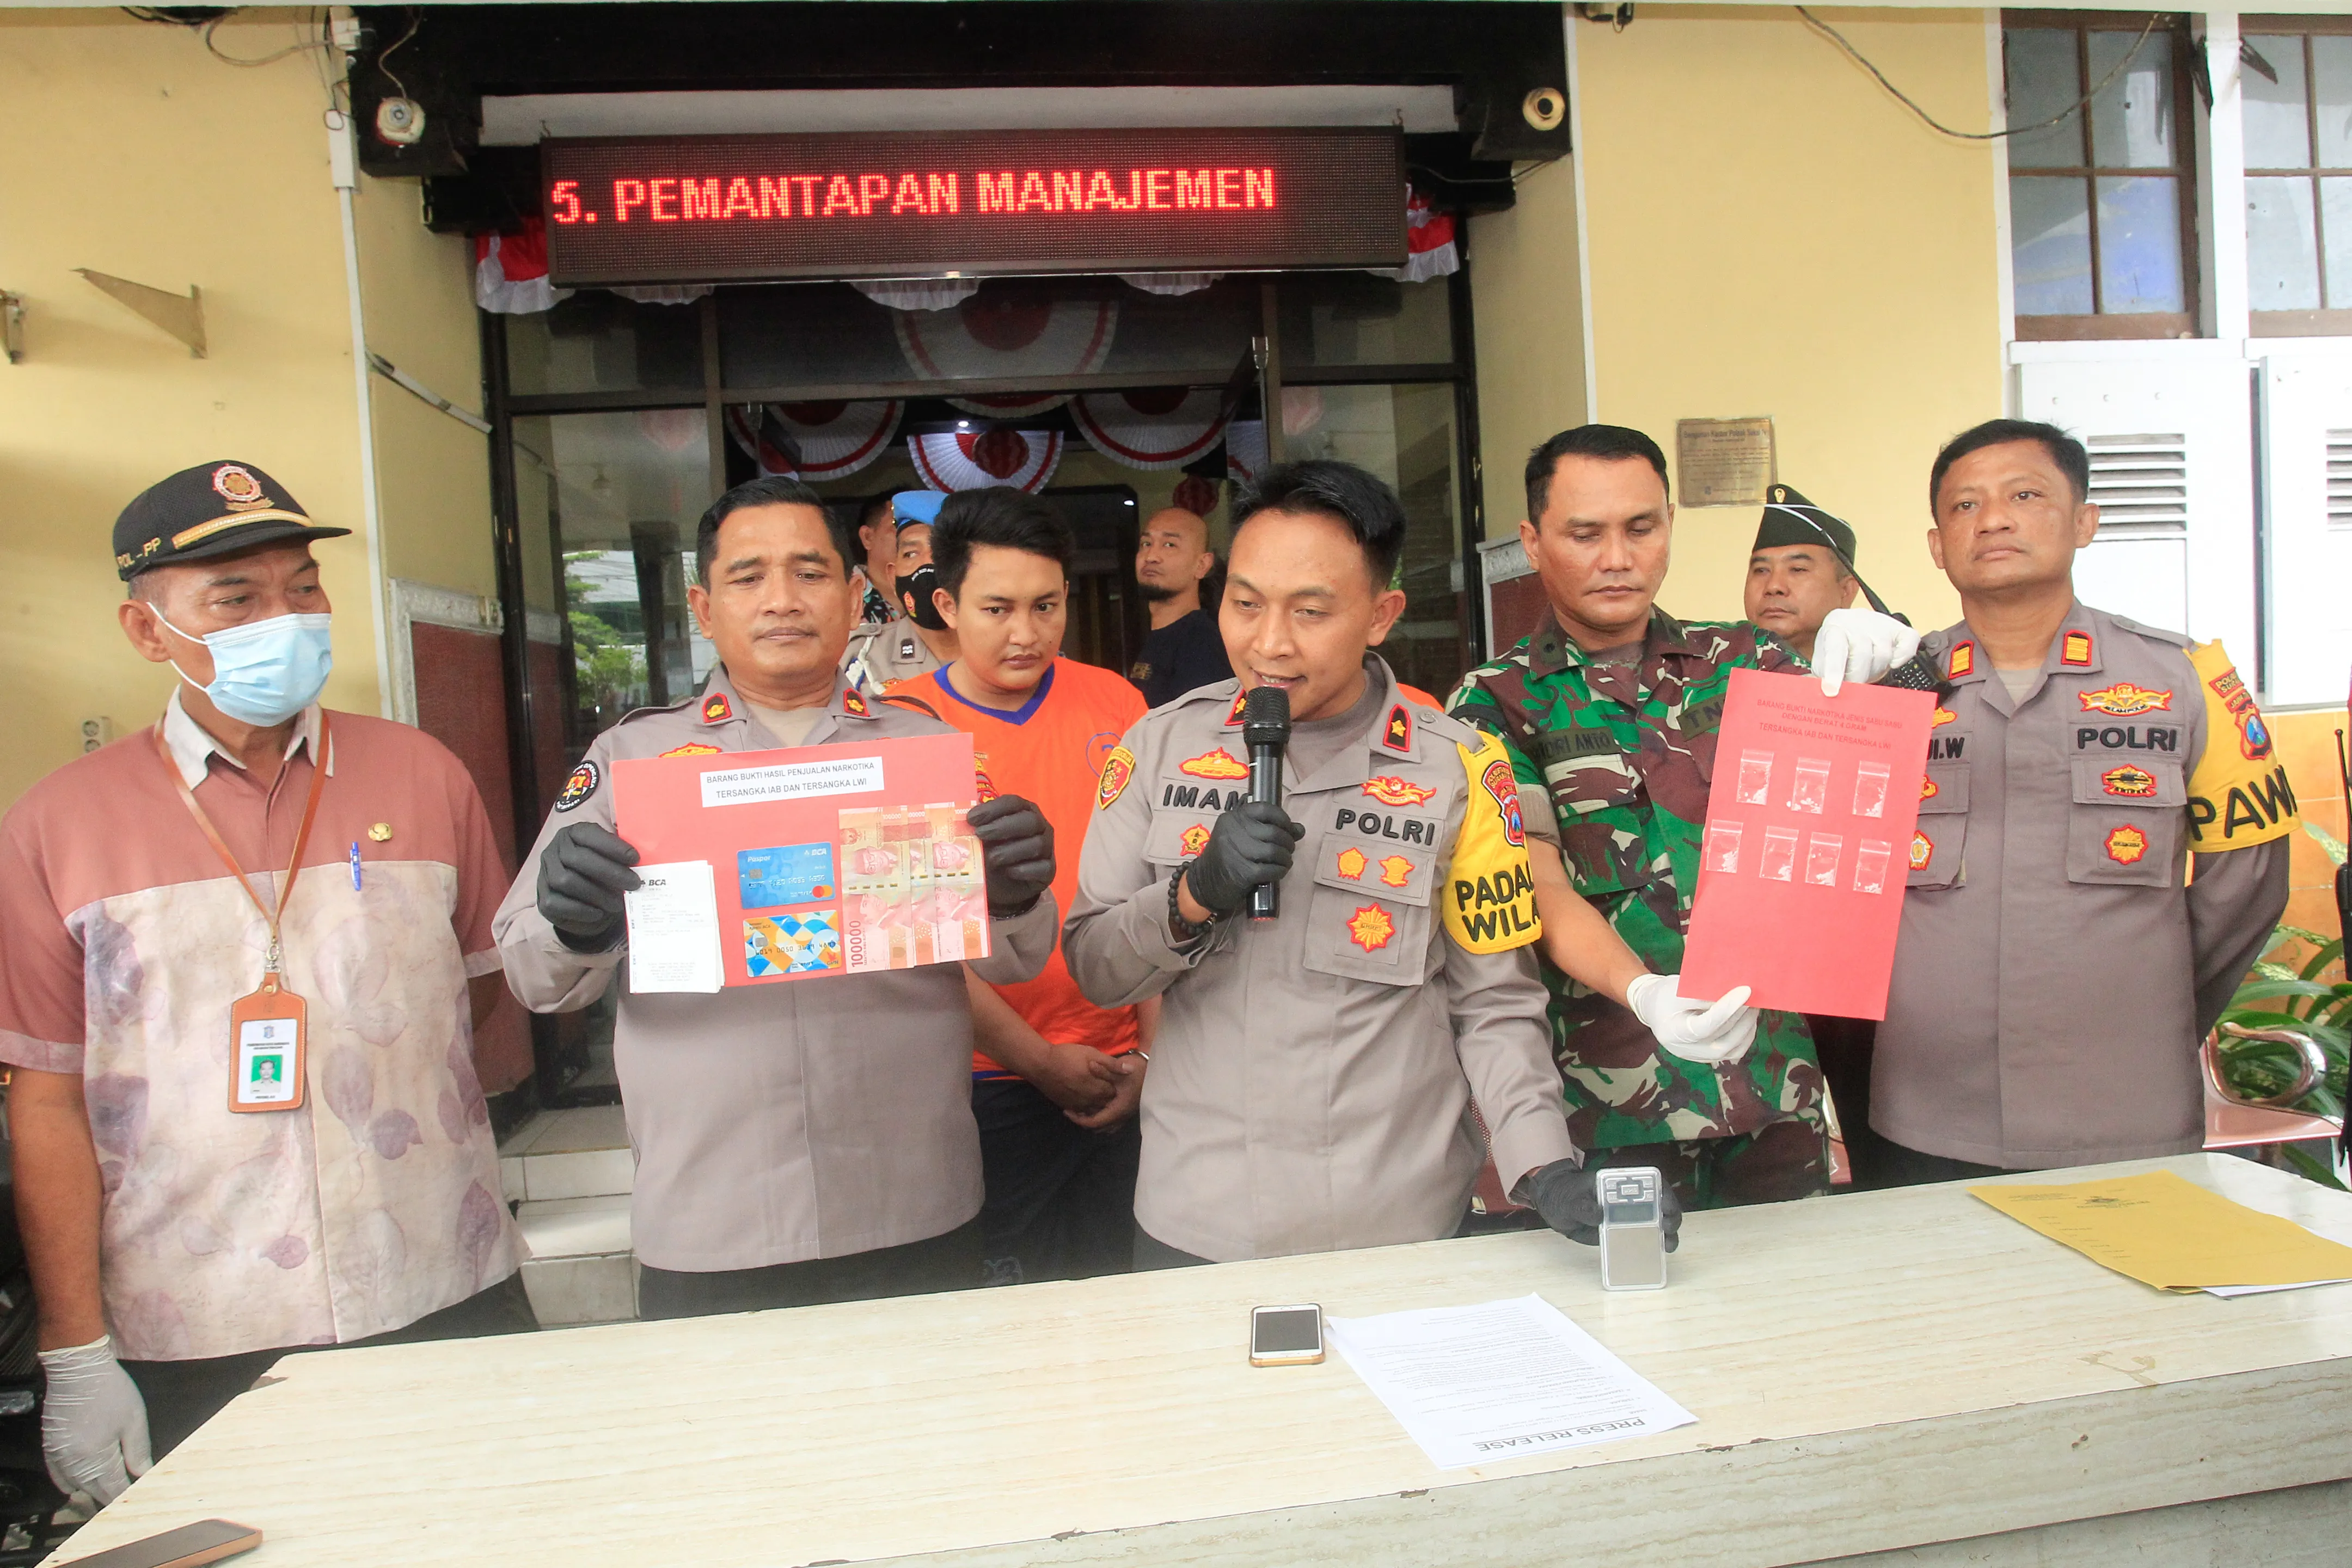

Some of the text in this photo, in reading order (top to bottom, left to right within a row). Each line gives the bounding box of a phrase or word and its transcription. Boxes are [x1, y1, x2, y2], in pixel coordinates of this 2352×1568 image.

[551, 168, 1274, 222] 5. PEMANTAPAN MANAJEMEN
[1757, 699, 1785, 710] BARANG
[1786, 704, 1806, 713] BUKTI
[1808, 708, 1845, 720] NARKOTIKA
[1866, 717, 1883, 726] SABU
[1782, 713, 1812, 723] DENGAN
[1814, 718, 1838, 726] BERAT
[1759, 722, 1802, 735] TERSANGKA
[1818, 732, 1833, 740] DAN
[1835, 735, 1877, 747] TERSANGKA
[2078, 726, 2177, 751] POLRI
[707, 762, 874, 783] BARANG BUKTI HASIL PENJUALAN NARKOTIKA
[716, 778, 867, 799] TERSANGKA IAB DAN TERSANGKA LWI
[1336, 808, 1435, 846] POLRI
[849, 921, 863, 967] 100000
[1576, 1418, 1646, 1435] PRESS
[1475, 1430, 1573, 1452] RELEASE
